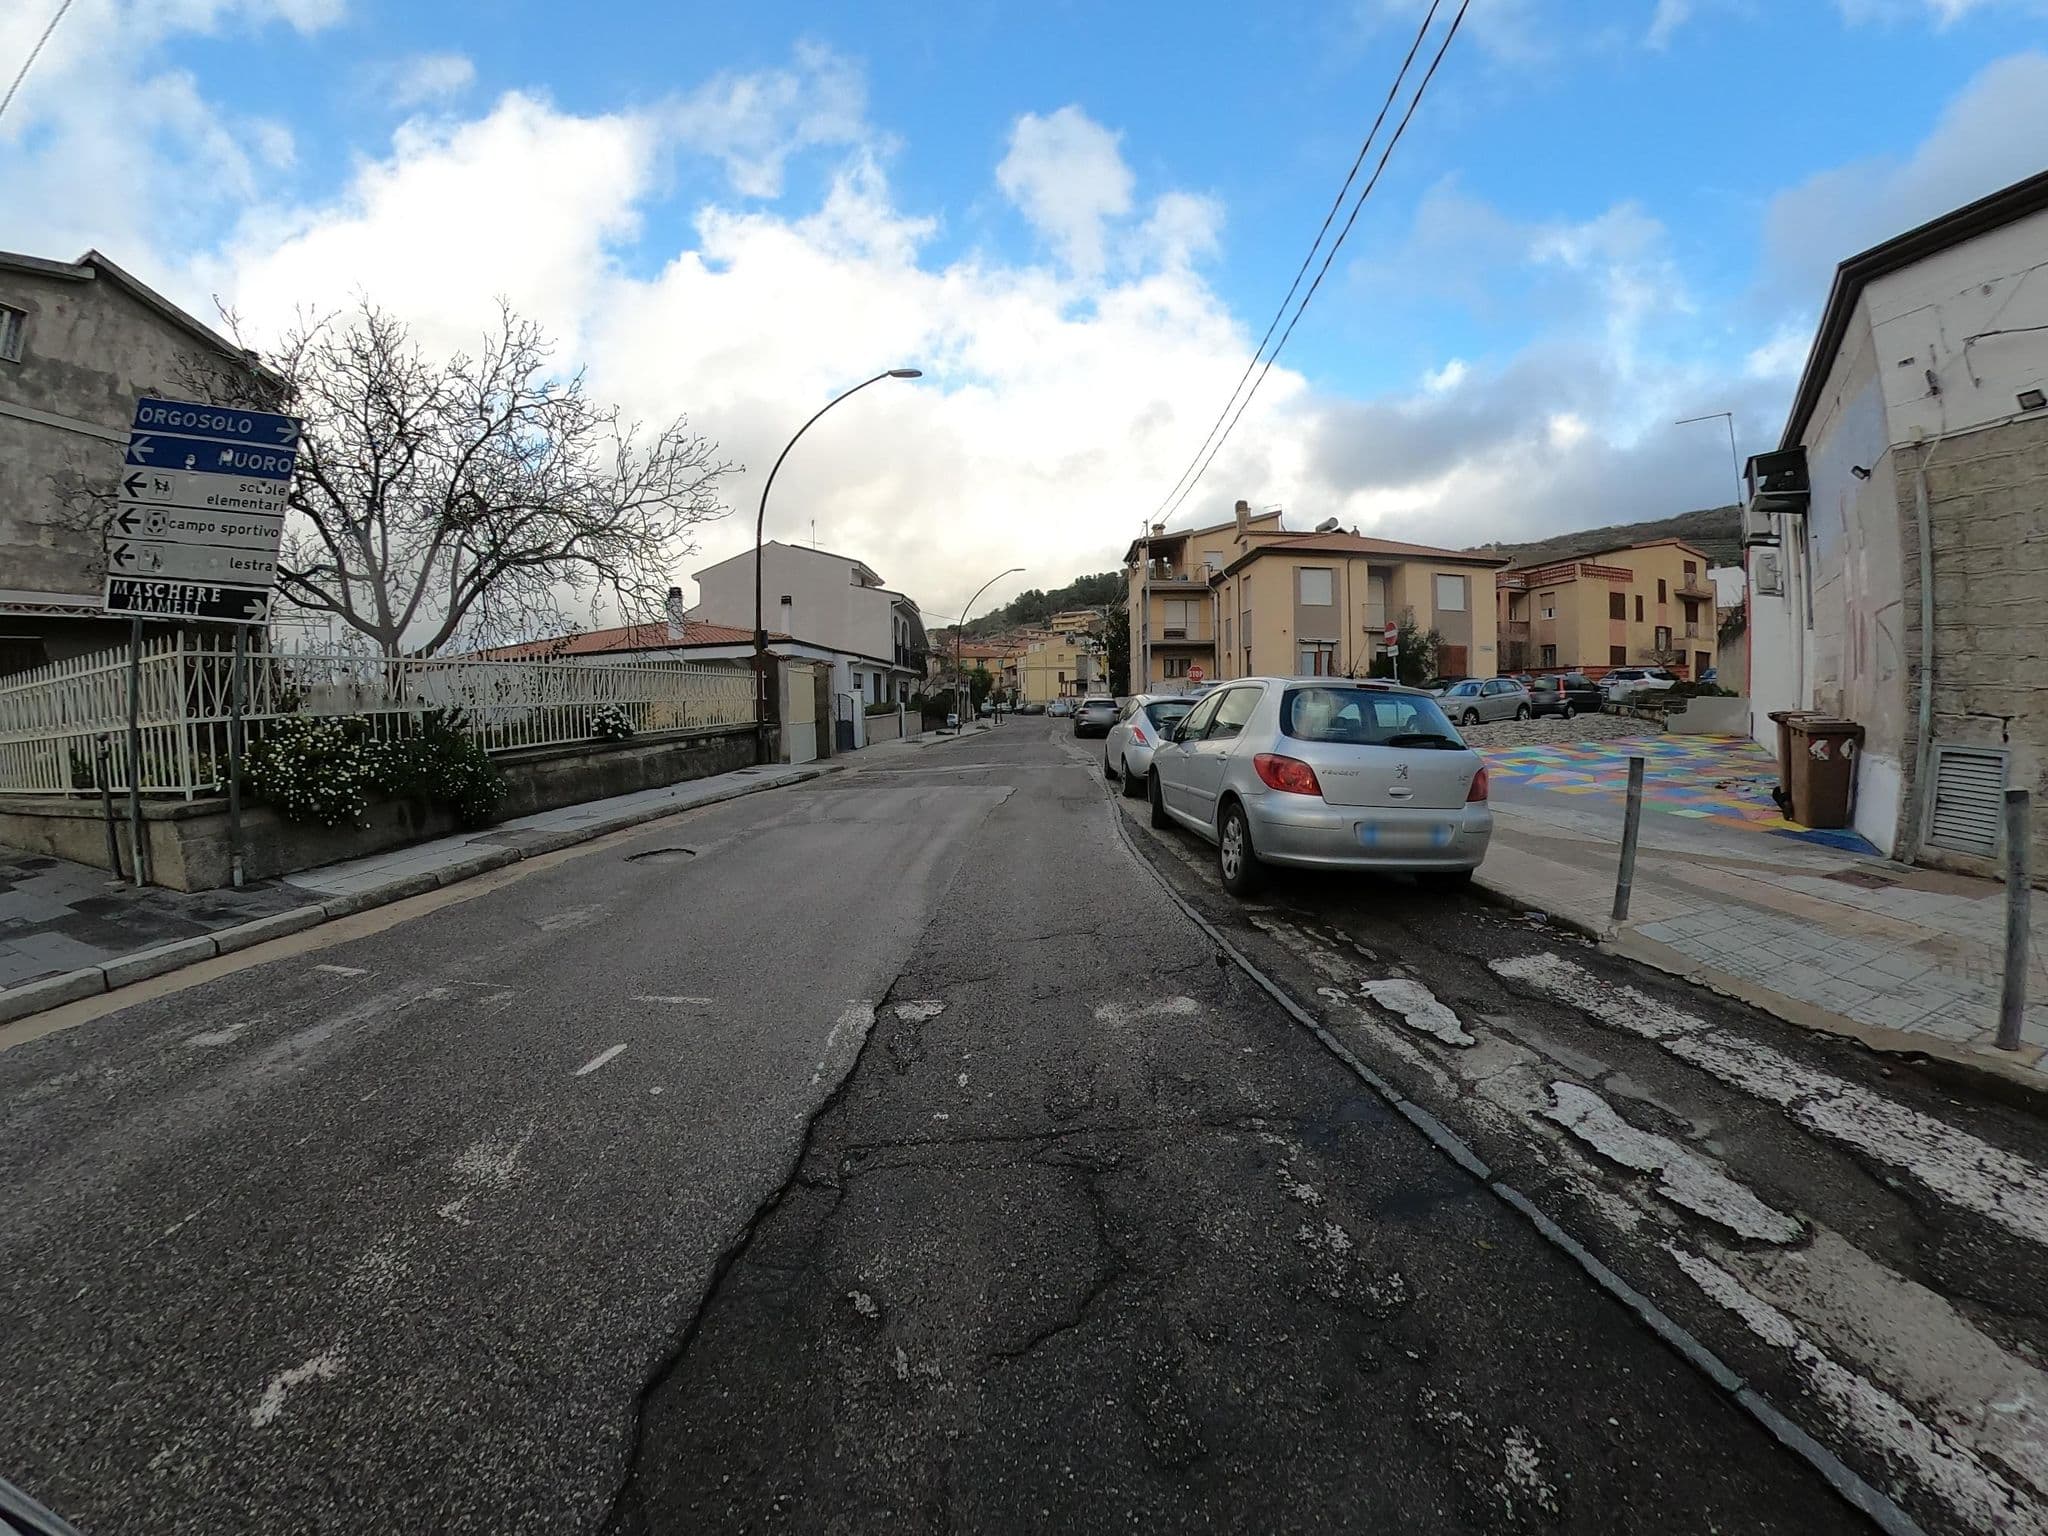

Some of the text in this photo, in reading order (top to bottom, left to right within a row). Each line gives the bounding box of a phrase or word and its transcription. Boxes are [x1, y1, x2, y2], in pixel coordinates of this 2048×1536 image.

[139, 407, 253, 434] ORGOSOLO
[218, 449, 292, 473] NUORO
[206, 494, 285, 512] elementari
[168, 520, 279, 538] campo sportivo
[113, 581, 221, 602] MASCHERE
[127, 596, 201, 616] MAMELI
[1188, 669, 1203, 679] STOP
